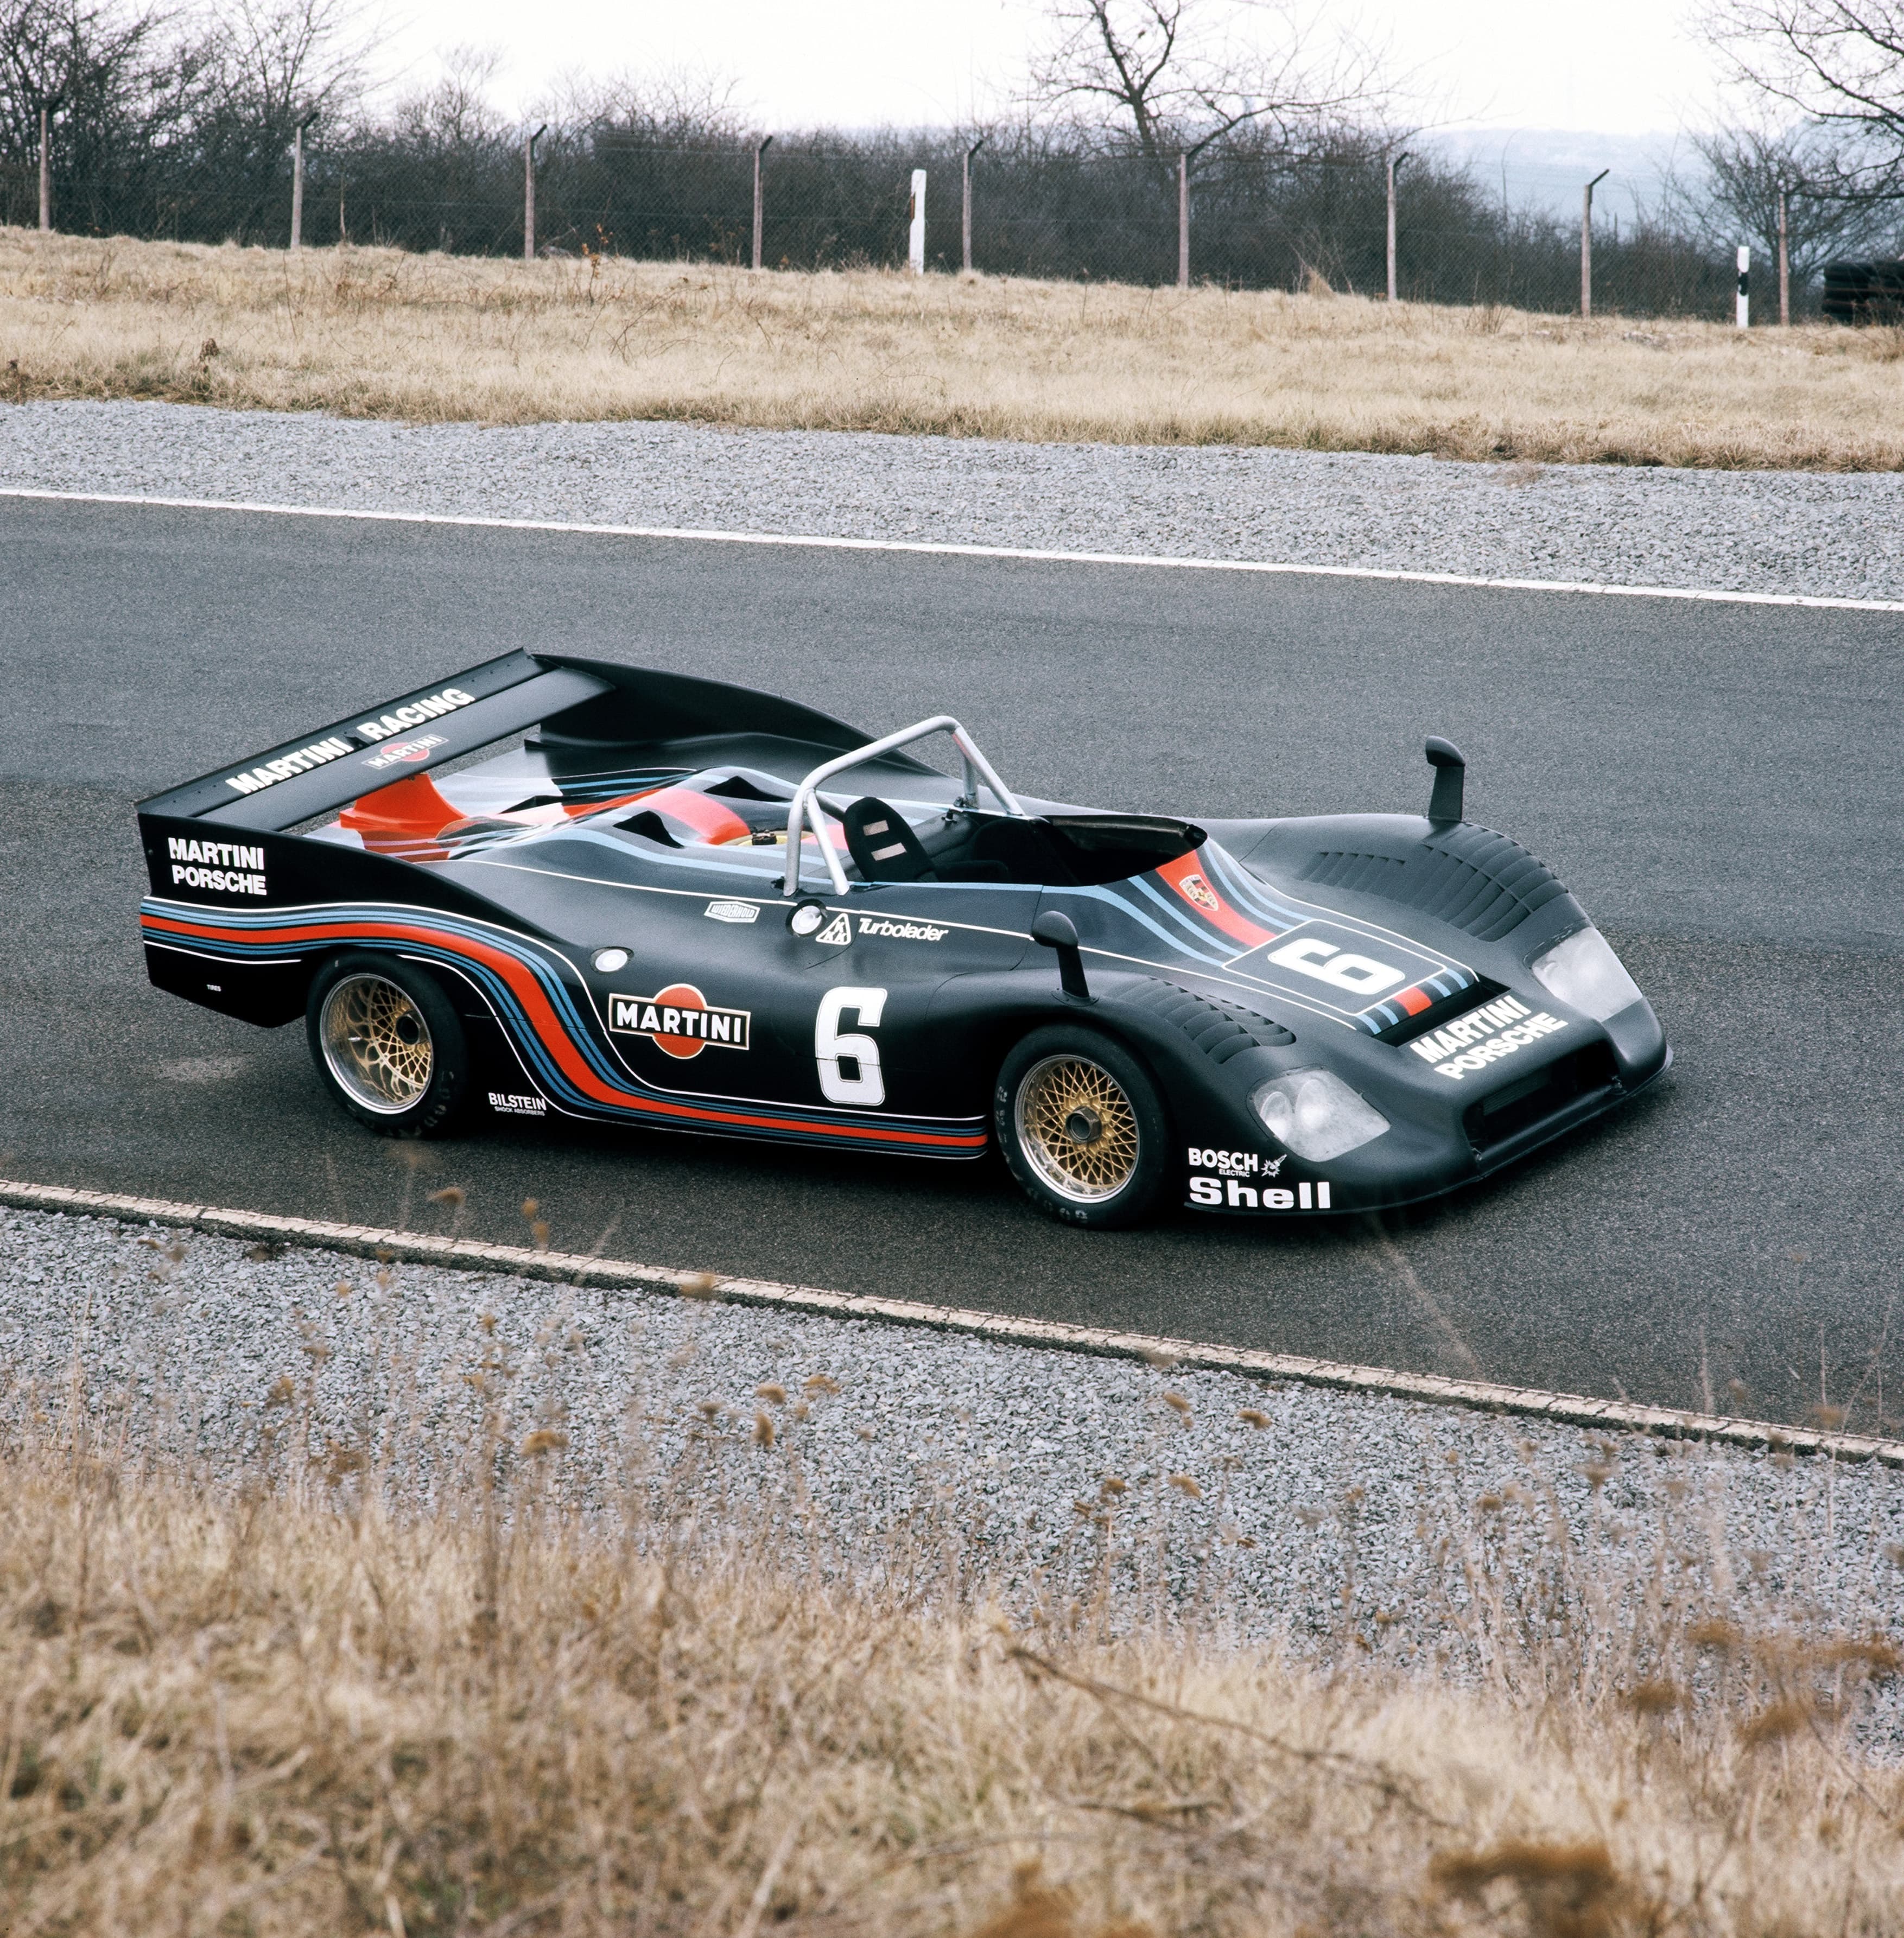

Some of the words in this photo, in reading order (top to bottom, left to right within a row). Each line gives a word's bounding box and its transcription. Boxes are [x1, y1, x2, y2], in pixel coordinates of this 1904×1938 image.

[226, 738, 354, 794] MARTINI
[357, 688, 475, 741] RACING
[368, 735, 442, 767] MARTINI
[168, 837, 264, 869] MARTINI
[172, 865, 267, 895] PORSCHE
[859, 918, 949, 941] Turbolader
[1267, 938, 1406, 995] 6
[617, 1002, 741, 1043] MARTINI
[1410, 995, 1532, 1064] MARTINI
[815, 986, 888, 1106] 6
[1433, 1012, 1569, 1080] PORSCHE
[488, 1092, 547, 1110] BILSTEIN
[1188, 1148, 1258, 1172] BOSCH
[1219, 1168, 1251, 1177] ELECTRIC
[1189, 1177, 1331, 1209] Shell
